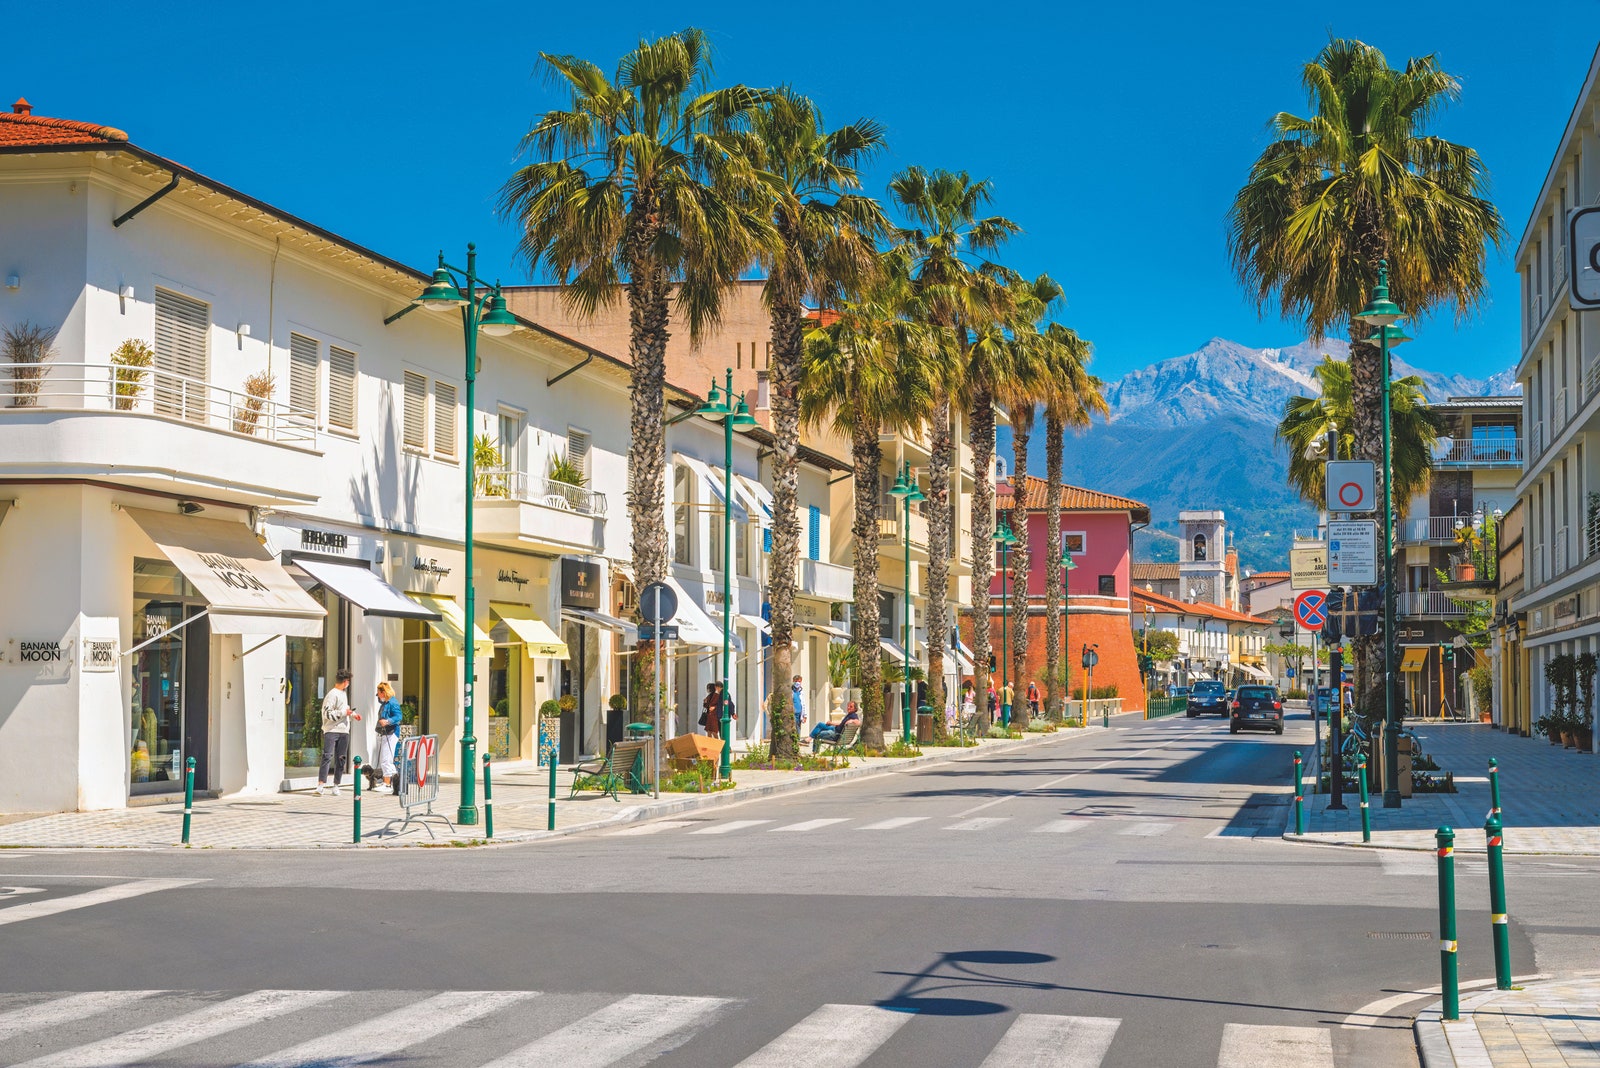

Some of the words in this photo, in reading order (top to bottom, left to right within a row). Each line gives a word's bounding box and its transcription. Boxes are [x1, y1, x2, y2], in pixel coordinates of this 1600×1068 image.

[197, 553, 251, 574] BANANA
[212, 570, 271, 592] MOON
[146, 615, 167, 624] BANANA
[146, 625, 167, 637] MOON
[20, 642, 60, 650] BANANA
[92, 642, 112, 650] BANANA
[20, 651, 61, 662] MOON
[92, 651, 112, 662] MOON
